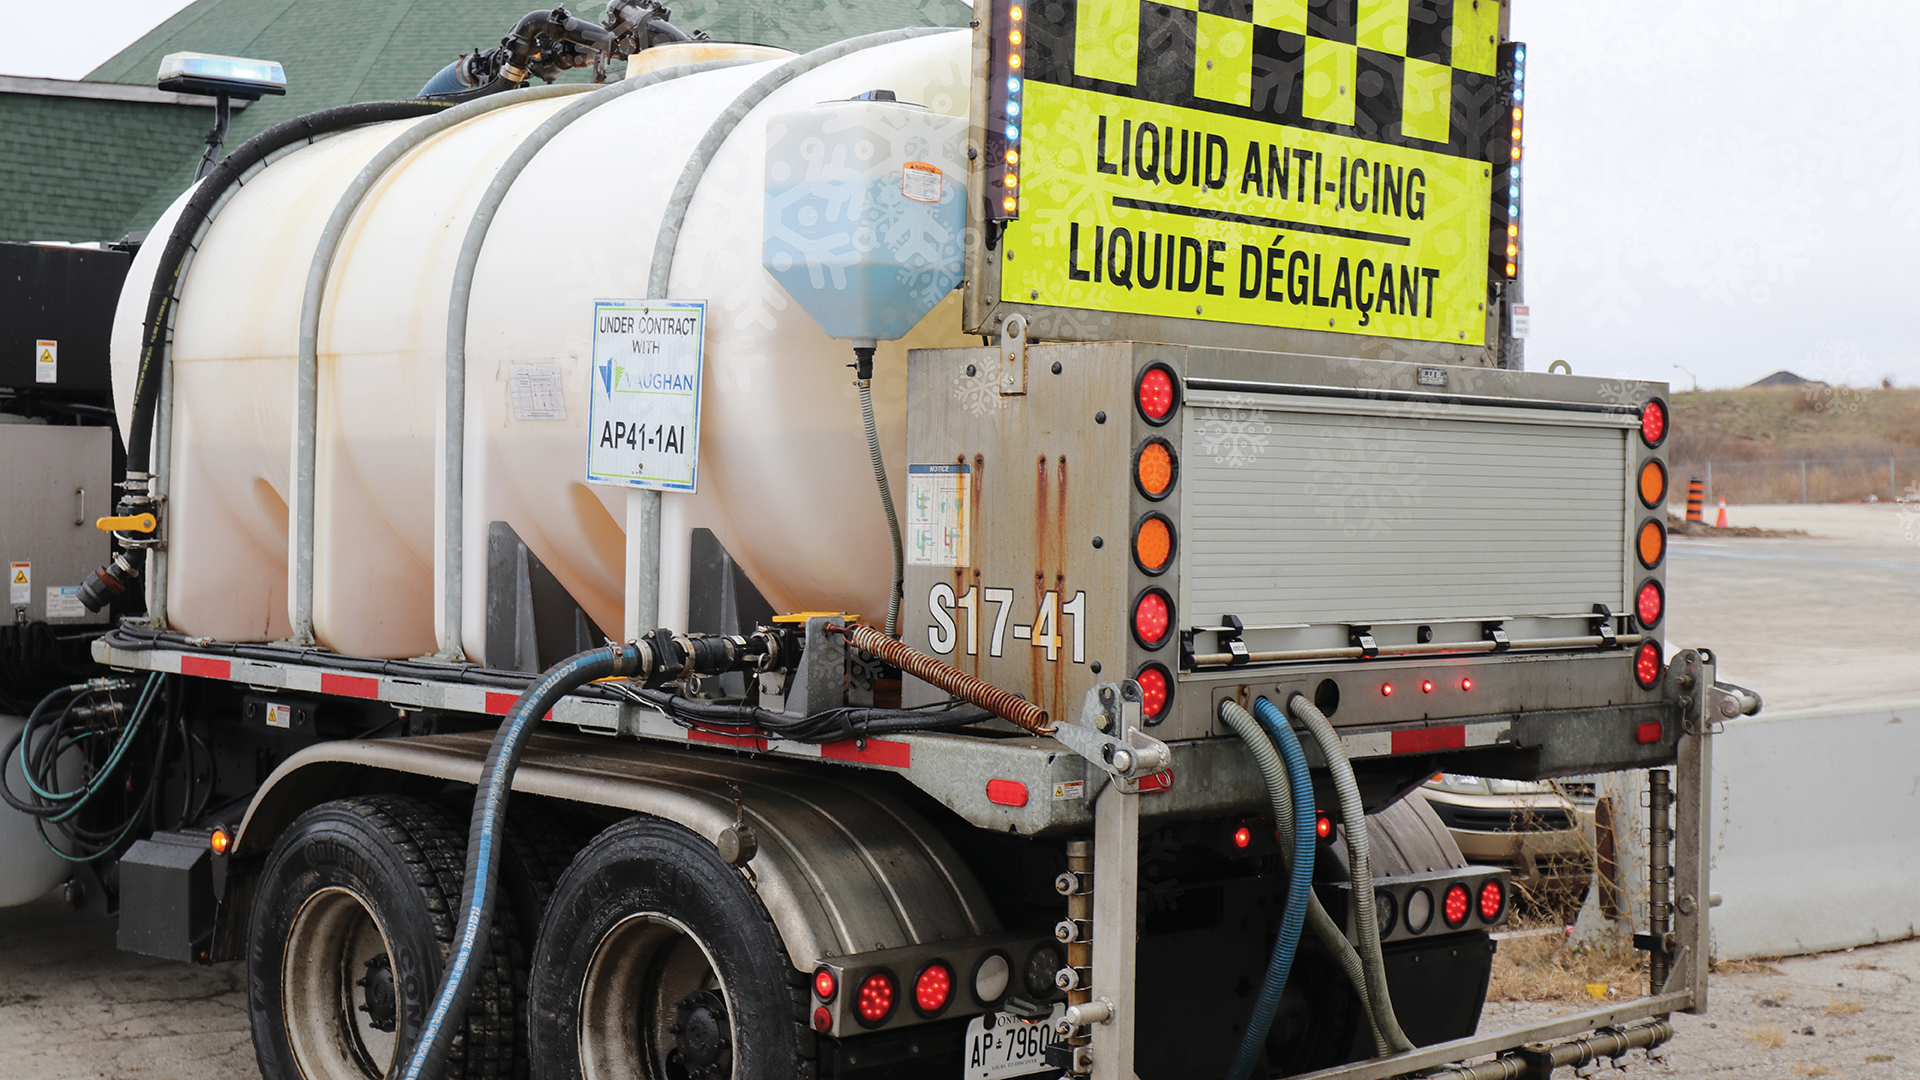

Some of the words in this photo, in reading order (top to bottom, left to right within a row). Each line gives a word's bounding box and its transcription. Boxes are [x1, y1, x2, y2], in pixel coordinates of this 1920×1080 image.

[1097, 115, 1228, 190] LIQUID
[1240, 140, 1426, 221] ANTI-ICING
[1068, 222, 1226, 296] LIQUIDE
[1239, 235, 1440, 326] DÉGLAÇANT
[600, 316, 635, 334] UNDER
[638, 316, 697, 336] CONTRACT
[632, 339, 660, 354] WITH
[600, 420, 685, 455] AP41-1AI
[928, 582, 1086, 665] S17-41
[971, 1032, 993, 1068] AP
